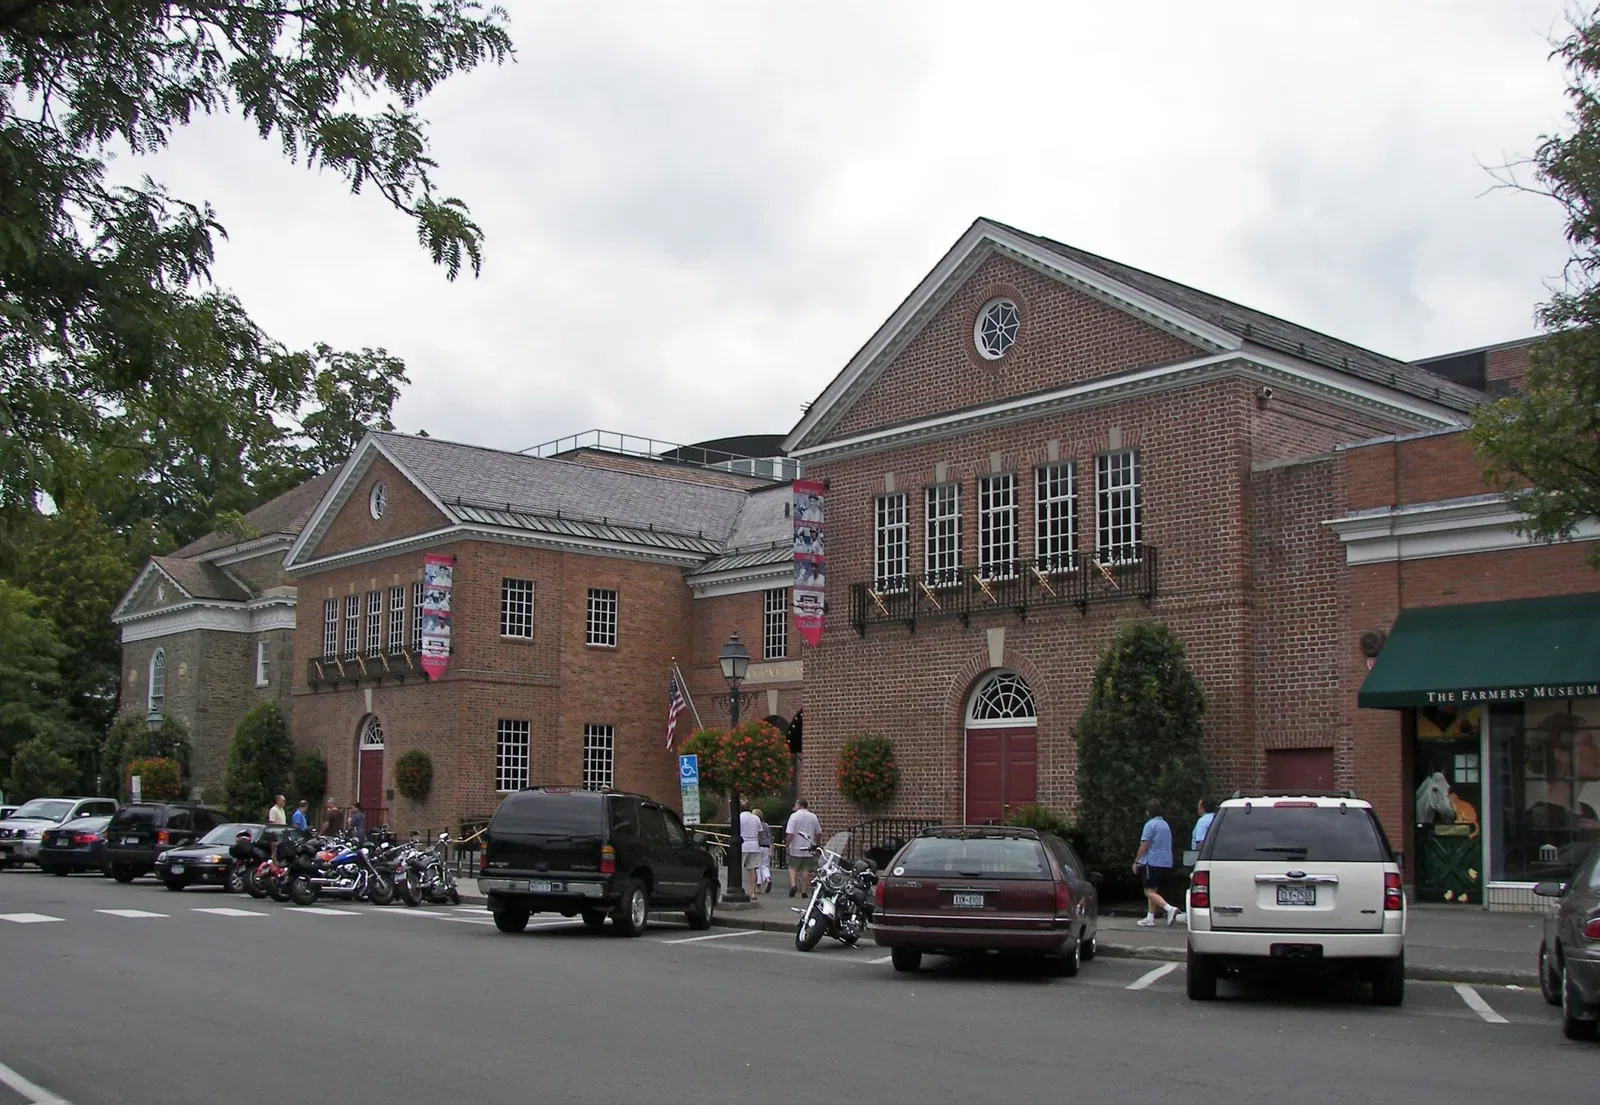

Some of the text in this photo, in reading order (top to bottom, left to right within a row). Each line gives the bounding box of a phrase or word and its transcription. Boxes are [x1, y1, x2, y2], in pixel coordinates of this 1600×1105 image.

[1426, 685, 1598, 703] THE FARMERS' MUSEUM
